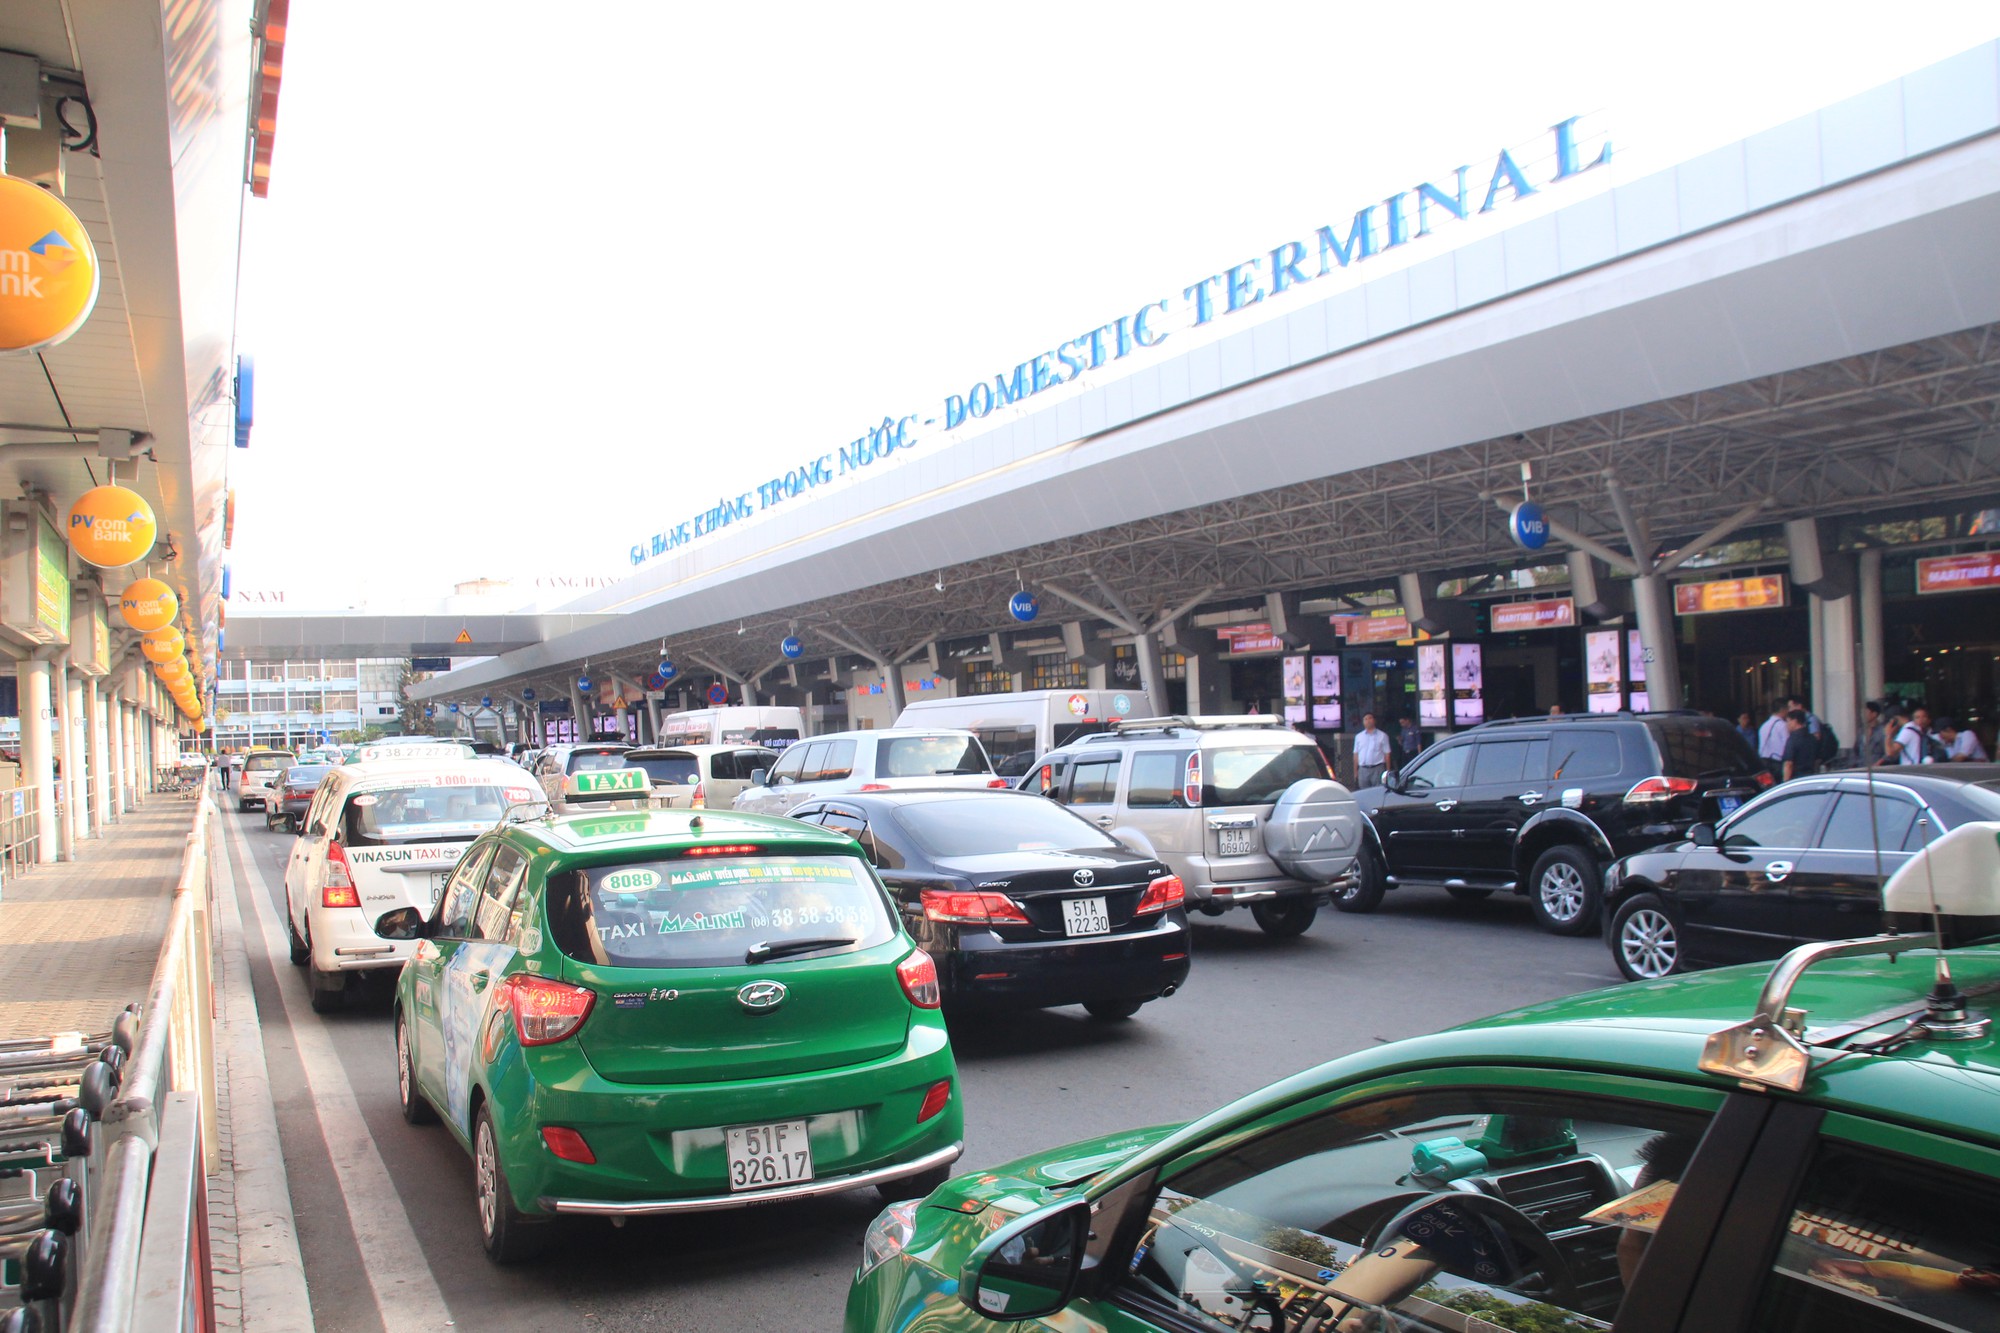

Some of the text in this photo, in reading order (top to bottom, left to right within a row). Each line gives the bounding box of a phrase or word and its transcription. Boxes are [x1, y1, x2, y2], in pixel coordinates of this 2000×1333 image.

[757, 454, 832, 510] TRONG
[945, 299, 1169, 431] DOMESTIC
[1184, 115, 1612, 327] TERMINAL
[1521, 521, 1543, 534] VIB
[1015, 603, 1032, 612] VIB
[785, 644, 799, 652] VIB
[435, 775, 466, 786] 3.000
[1227, 830, 1243, 841] 51A
[352, 848, 440, 863] VINASUN TAXI
[610, 872, 653, 889] 8089
[1073, 900, 1098, 917] 51A
[597, 922, 646, 941] TAXI
[751, 916, 770, 929] (08)
[771, 907, 794, 928] 38
[799, 906, 820, 924] 38
[825, 905, 845, 924] 38
[1067, 916, 1108, 934] 122.30
[650, 988, 679, 1001] i10
[746, 1125, 788, 1156] 51F
[733, 1151, 808, 1186] 326.17
